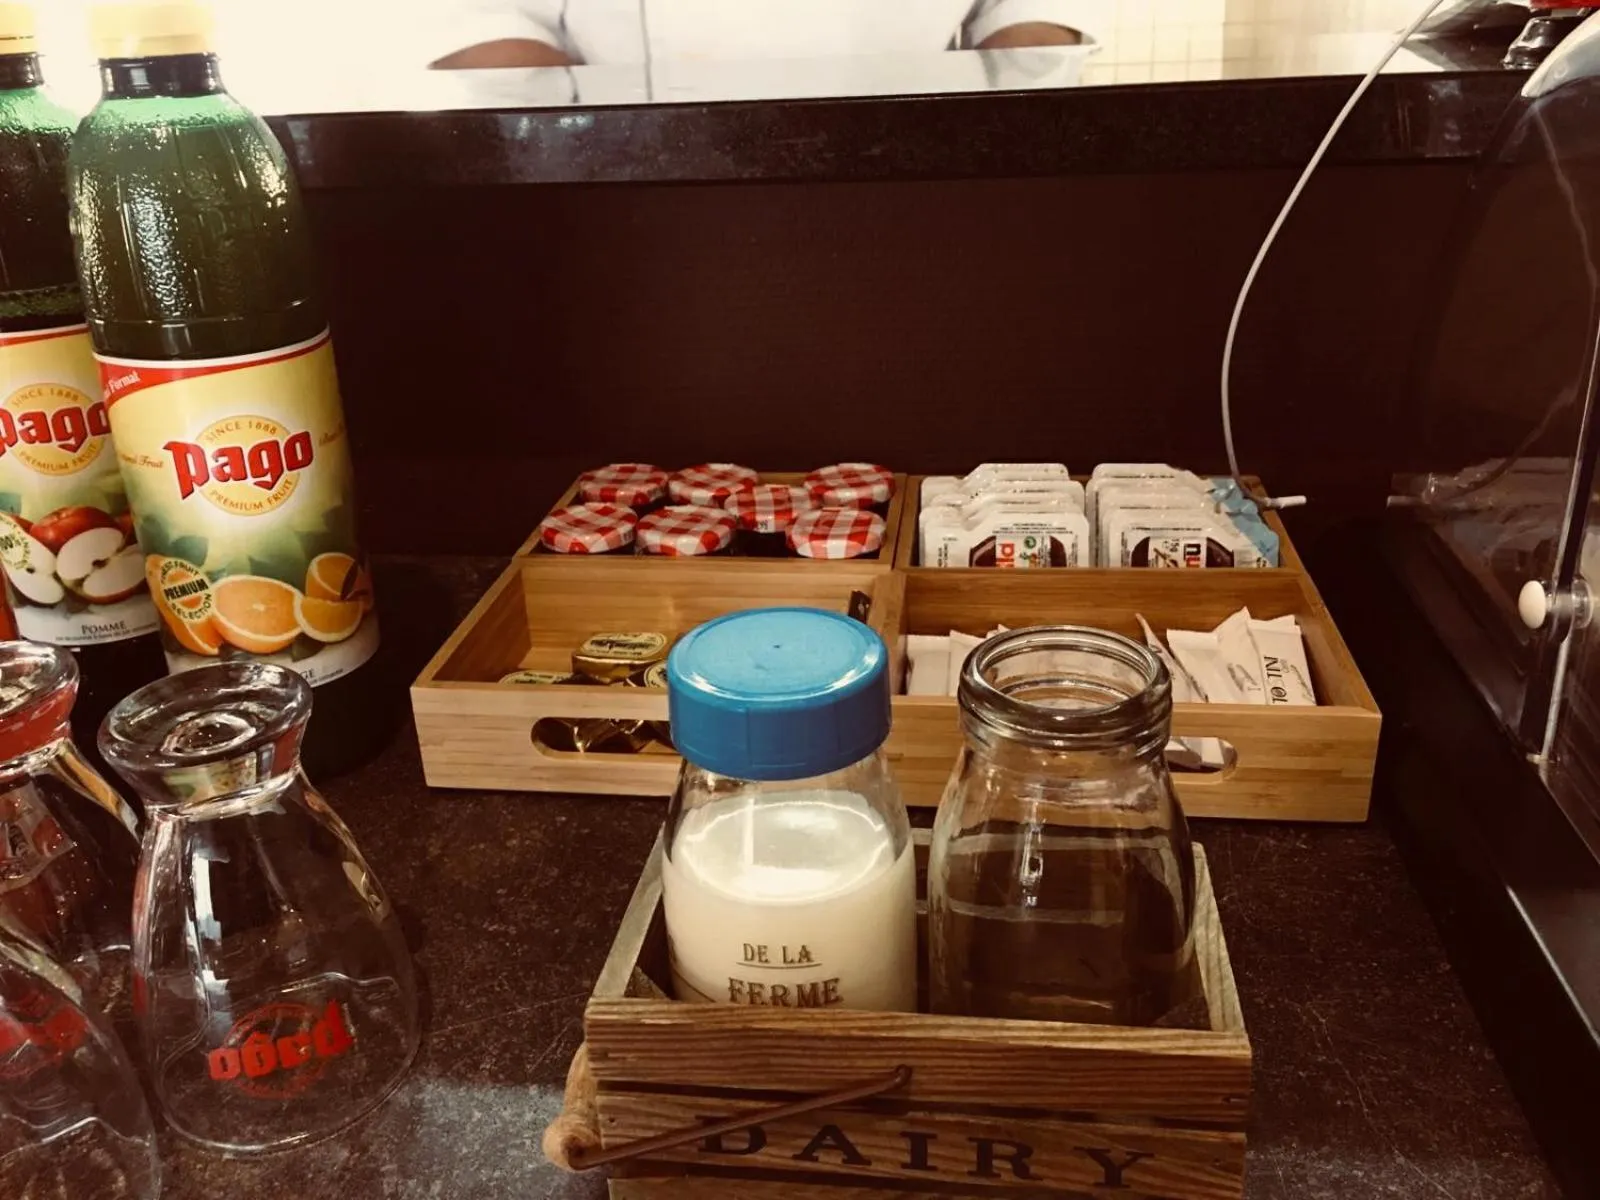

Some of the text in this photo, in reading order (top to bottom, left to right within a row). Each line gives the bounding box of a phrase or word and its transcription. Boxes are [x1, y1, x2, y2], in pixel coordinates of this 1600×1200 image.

[50, 387, 79, 401] 1888
[206, 420, 277, 443] SINCE 1888
[162, 430, 313, 500] pago
[209, 478, 293, 511] PREMIUM FRUIT
[164, 578, 208, 601] PREMIUM
[81, 621, 128, 635] POMME
[742, 943, 814, 965] DE LA
[728, 977, 844, 1009] FERME
[695, 1115, 1155, 1188] DAIRY
